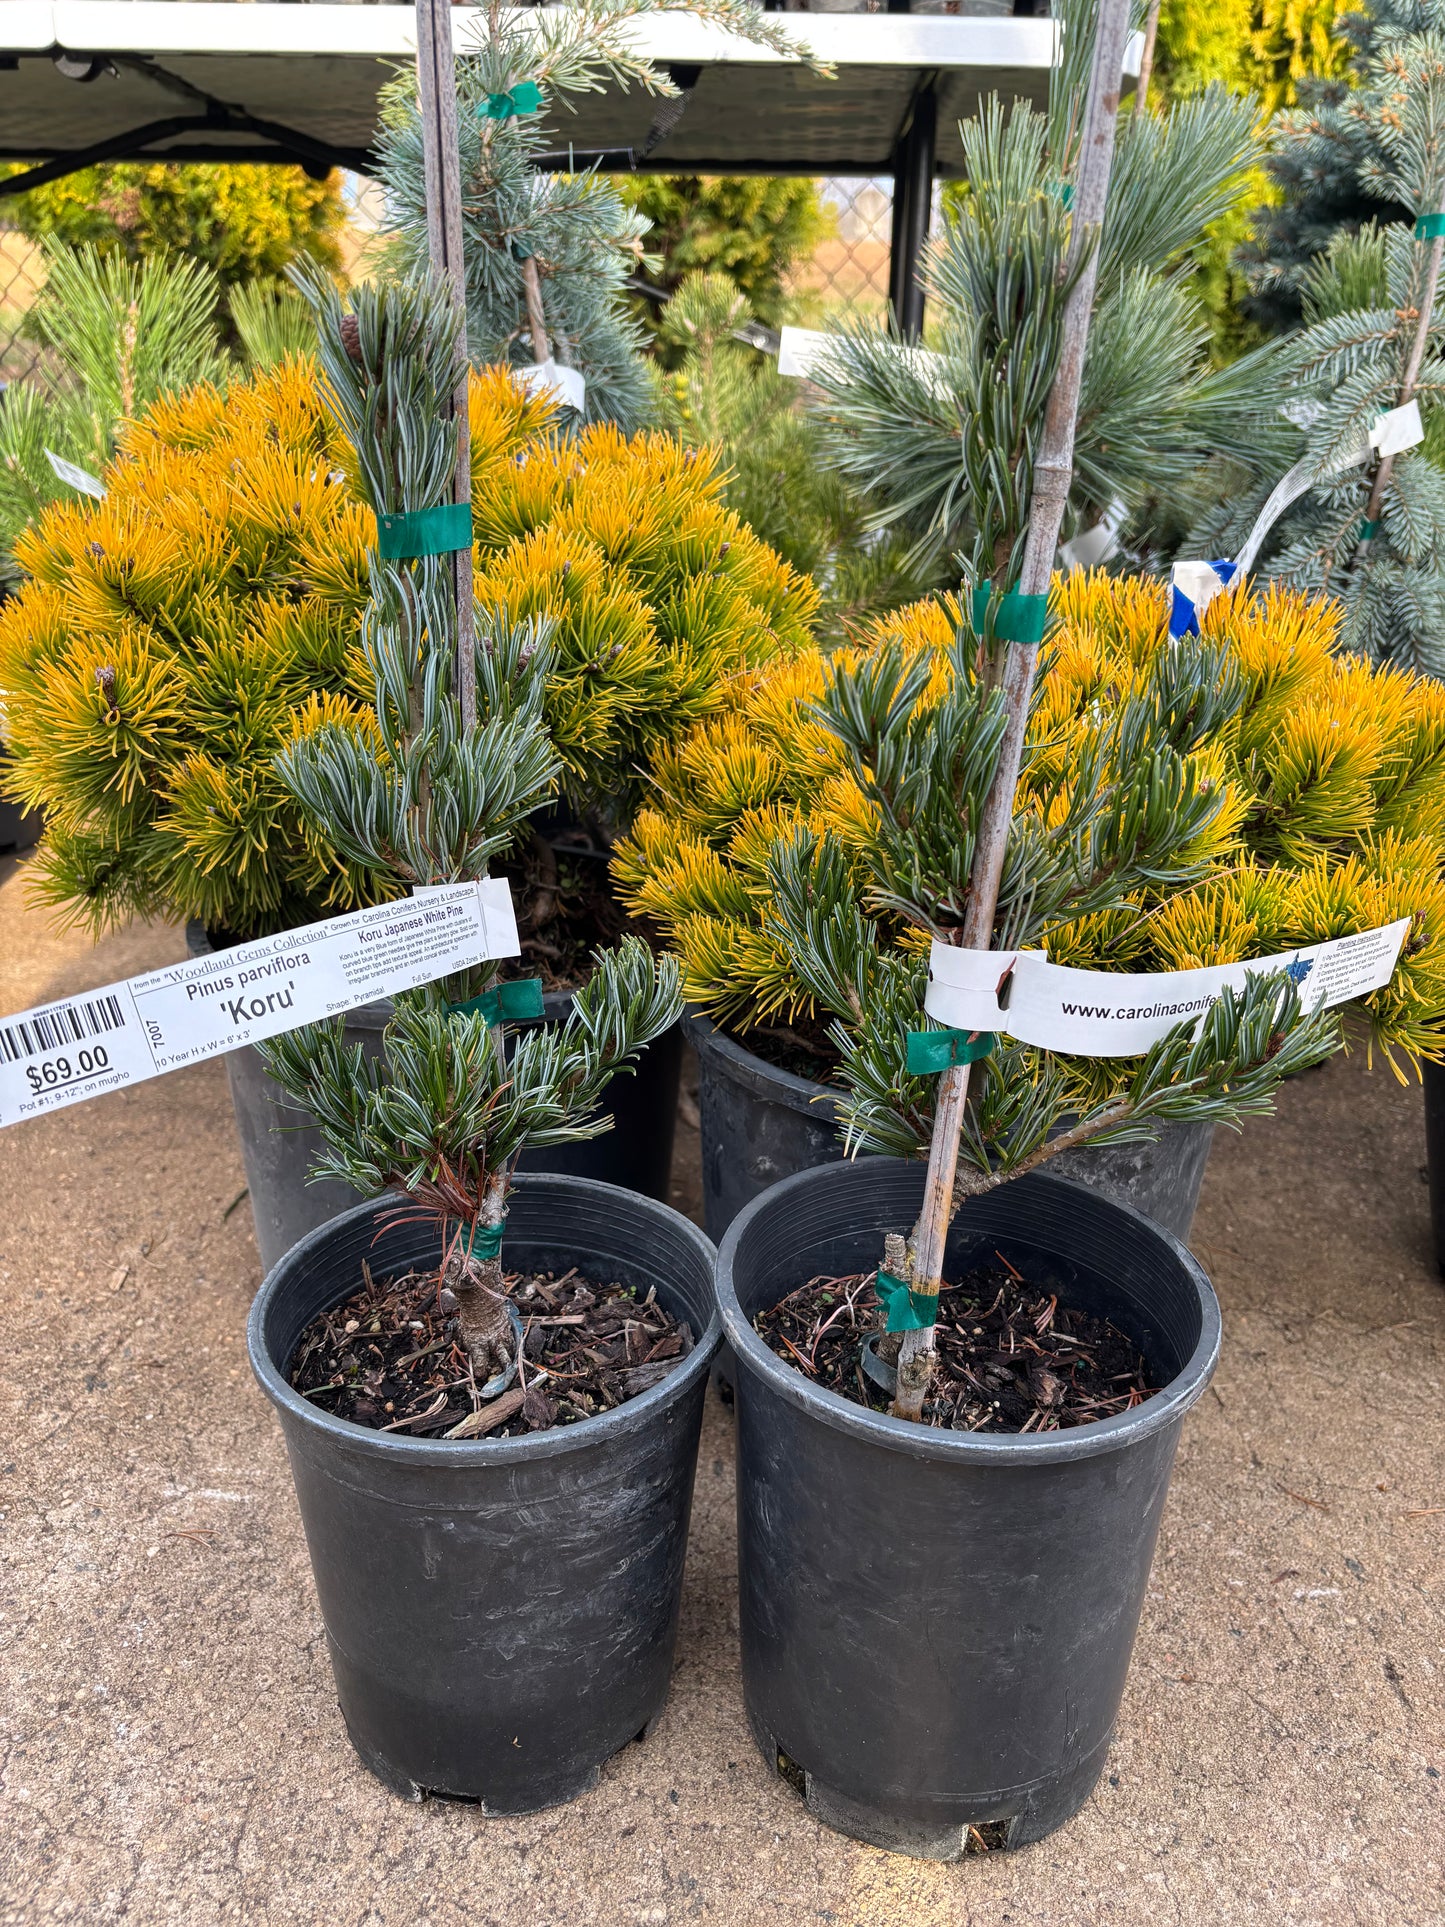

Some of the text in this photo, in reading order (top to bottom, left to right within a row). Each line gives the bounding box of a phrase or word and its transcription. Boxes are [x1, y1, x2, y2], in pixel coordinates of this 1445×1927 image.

[134, 886, 474, 990] from the "Woodland Gems Collection" Grown for Carolina Conifers Nursery & Landscape
[358, 905, 464, 944] Koru Japanese White Pine
[339, 952, 354, 961] Koru
[364, 947, 375, 955] very
[376, 942, 386, 950] Blue
[387, 940, 398, 948] form
[398, 936, 403, 944] of
[404, 932, 424, 943] Japanese
[424, 928, 436, 936] White
[342, 960, 361, 970] curved
[362, 956, 374, 964] blue
[374, 952, 388, 961] green
[388, 945, 406, 956] needles
[186, 952, 311, 1000] Pinus parviflora
[345, 970, 354, 978] on
[354, 964, 372, 975] branch
[372, 962, 382, 970] tips
[382, 957, 392, 966] add
[370, 966, 394, 979] branching
[395, 962, 404, 971] and
[412, 972, 432, 984] Full Sun
[452, 960, 466, 970] USDA
[220, 981, 296, 1025] 'Koru'
[326, 986, 385, 1012] Shape: Pyramidal
[146, 1020, 165, 1049] 7007
[157, 1057, 167, 1068] 10
[168, 1051, 190, 1064] Year
[191, 1047, 200, 1056] H
[206, 1041, 218, 1052] W
[219, 1038, 226, 1046] =
[227, 1034, 235, 1044] 6'
[26, 1045, 110, 1093] $69.00
[19, 1099, 36, 1113] Pot
[84, 1082, 98, 1092] on
[98, 1070, 130, 1086] mugho
